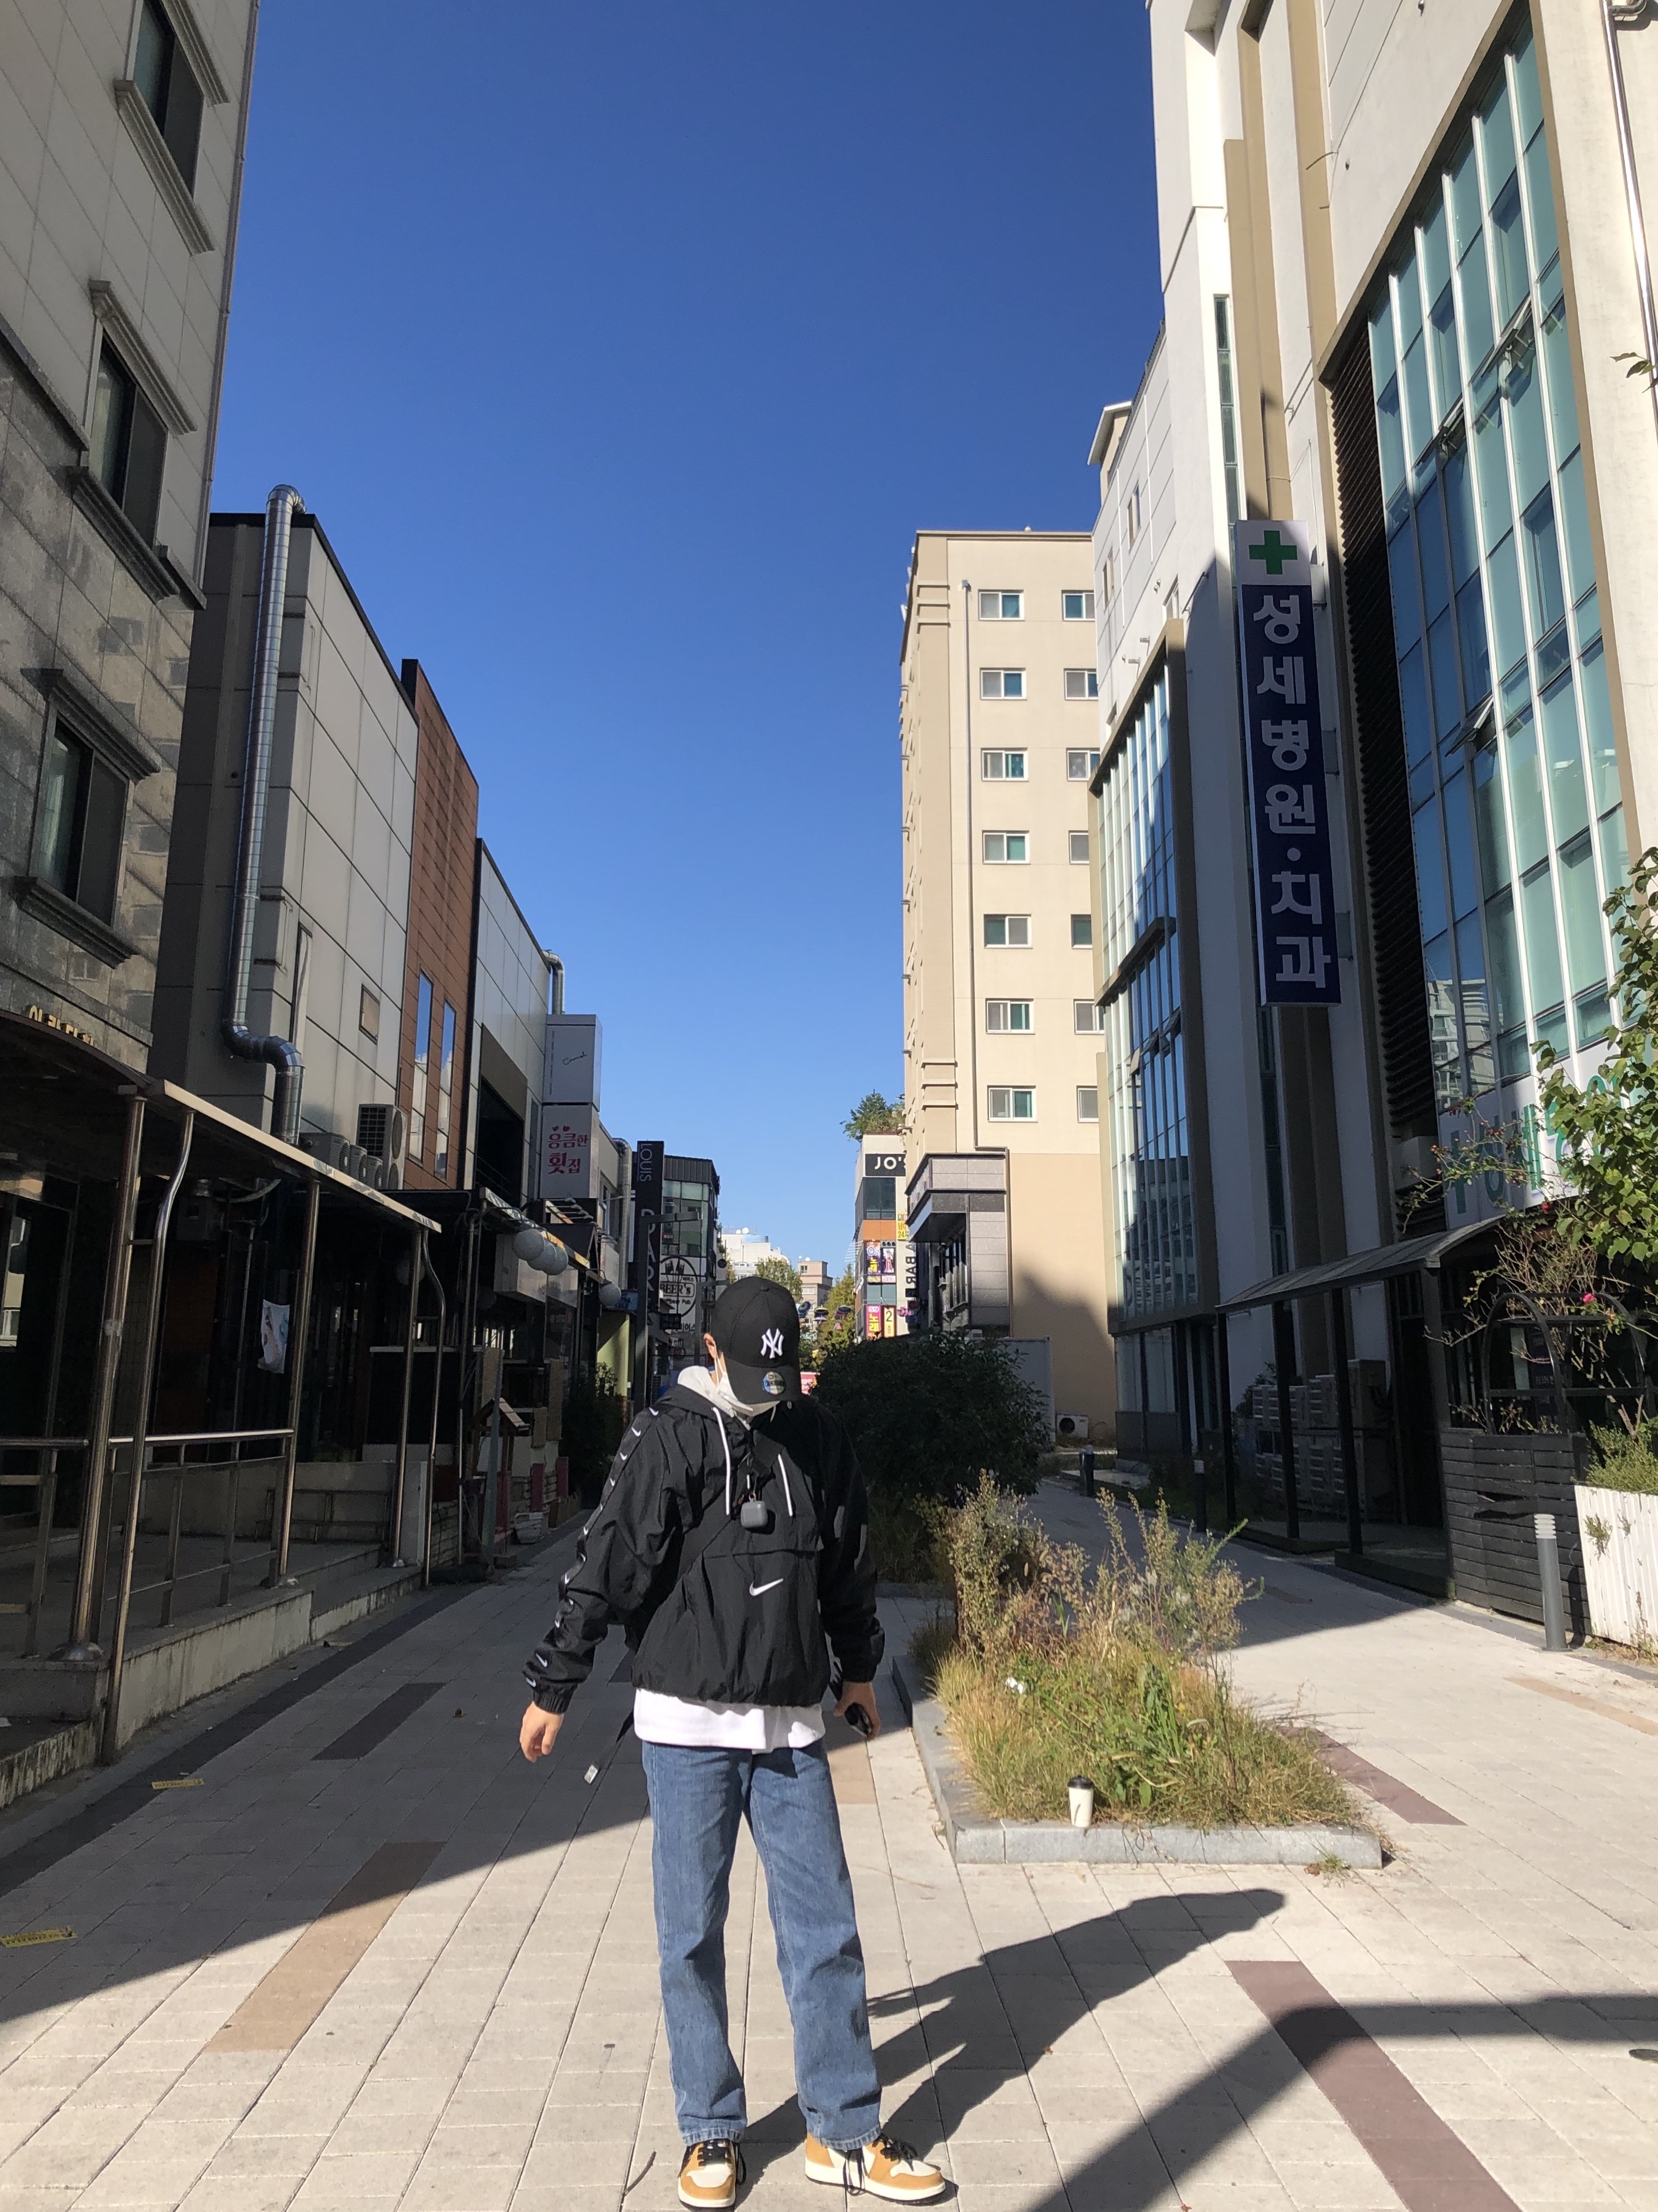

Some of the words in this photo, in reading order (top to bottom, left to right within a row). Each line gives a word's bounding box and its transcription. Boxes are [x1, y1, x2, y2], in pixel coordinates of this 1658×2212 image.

[547, 1132, 588, 1149] 응큼한
[548, 1152, 581, 1174] 횟집
[639, 1143, 652, 1182] LOUIS
[874, 1156, 906, 1170] JO'
[760, 1328, 784, 1359] NY
